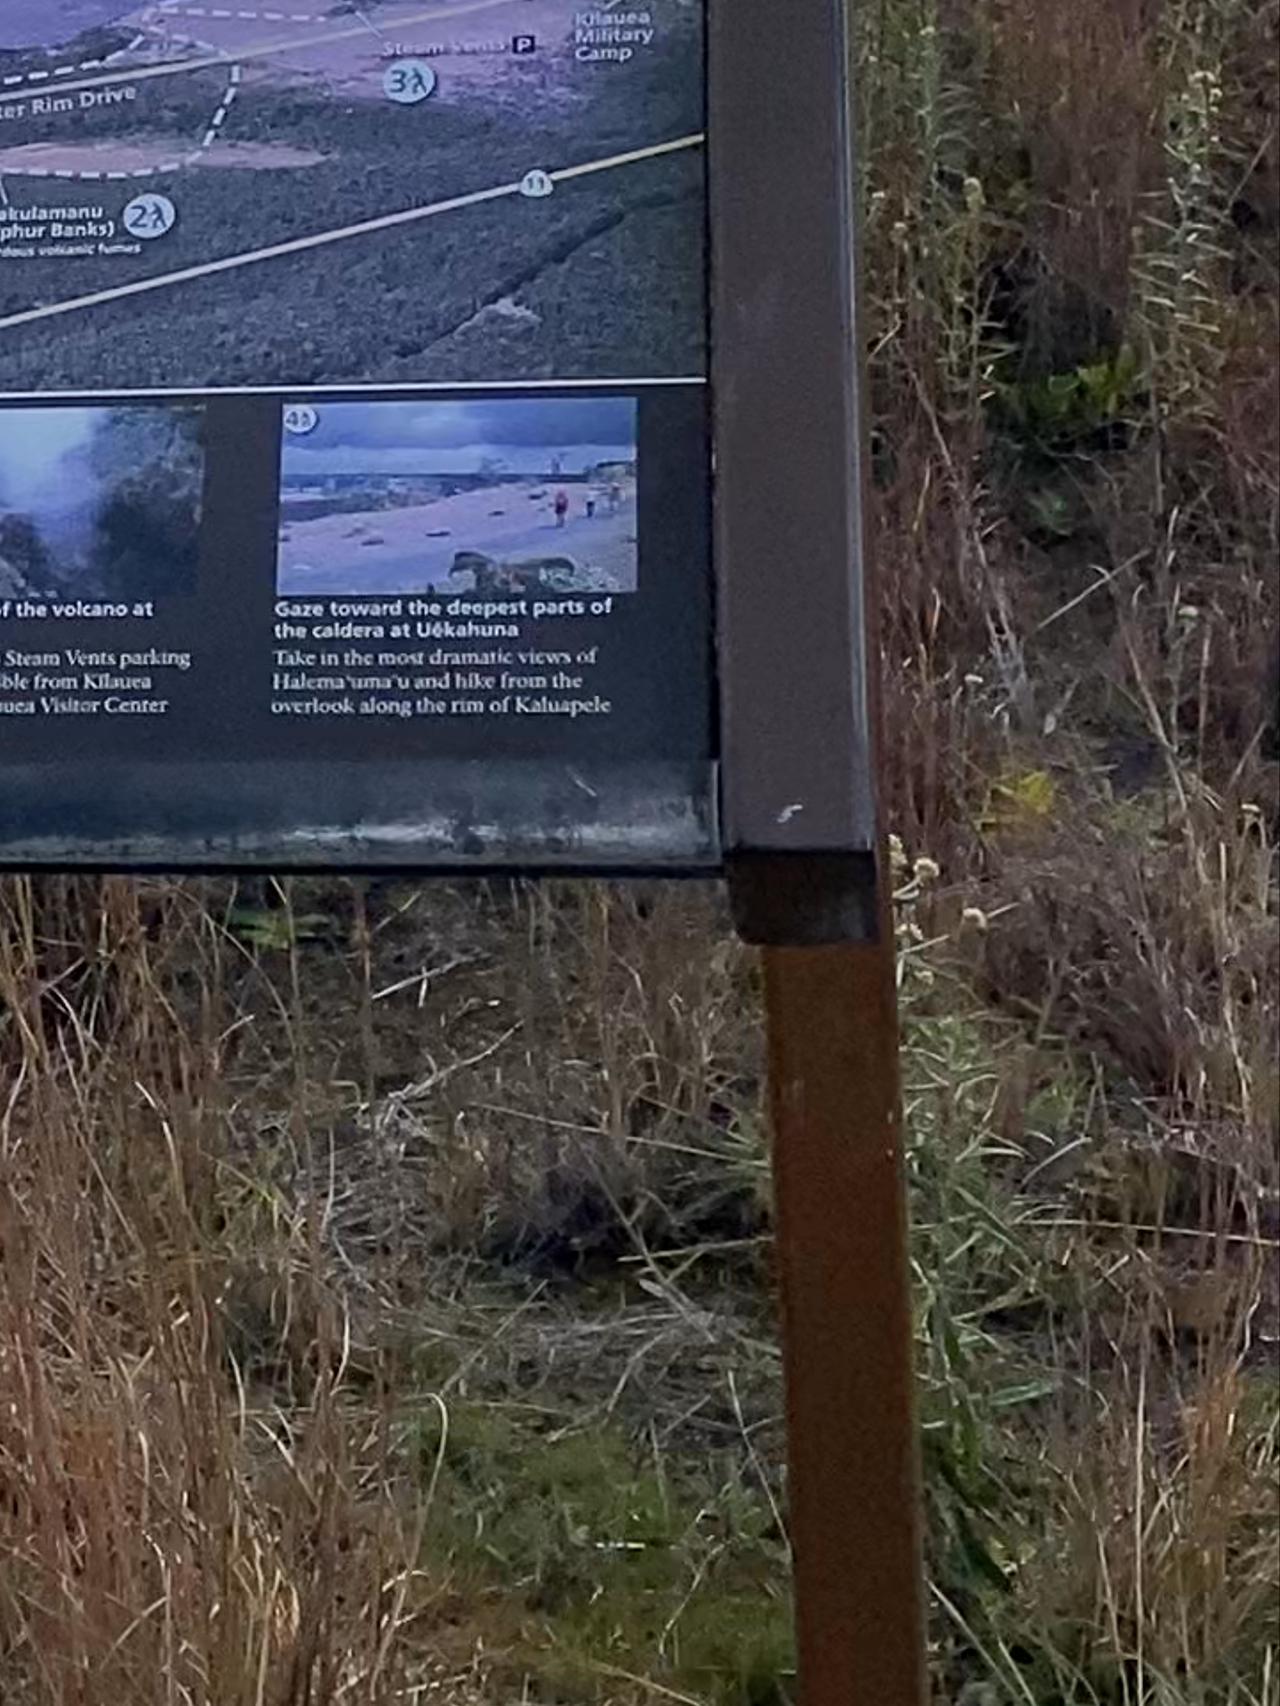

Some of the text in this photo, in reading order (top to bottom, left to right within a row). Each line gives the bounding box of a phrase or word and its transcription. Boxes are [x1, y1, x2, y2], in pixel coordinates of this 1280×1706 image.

[575, 28, 653, 44] Military
[575, 46, 632, 62] Camp
[389, 70, 407, 92] 3
[28, 98, 74, 119] Rim
[78, 86, 138, 109] Drive
[129, 204, 148, 227] 2
[50, 221, 116, 240] Banks)
[16, 602, 47, 617] the
[52, 601, 128, 616] volcano
[132, 602, 154, 616] at
[275, 597, 612, 619] Gaze toward the deepest parts of
[274, 623, 307, 638] the
[312, 622, 385, 638] caldera
[390, 623, 411, 638] at
[5, 650, 61, 666] Steam
[65, 649, 115, 666] Vents
[119, 649, 191, 669] parking
[273, 647, 597, 666] Take in the most dramatic views of
[33, 673, 78, 689] from
[414, 673, 450, 689] and
[455, 672, 495, 689] hike
[500, 672, 546, 688] from
[552, 671, 583, 688] the
[40, 697, 100, 714] Visitor
[104, 696, 169, 713] Center
[271, 695, 612, 718] overlook along the rim of Kaluapele
